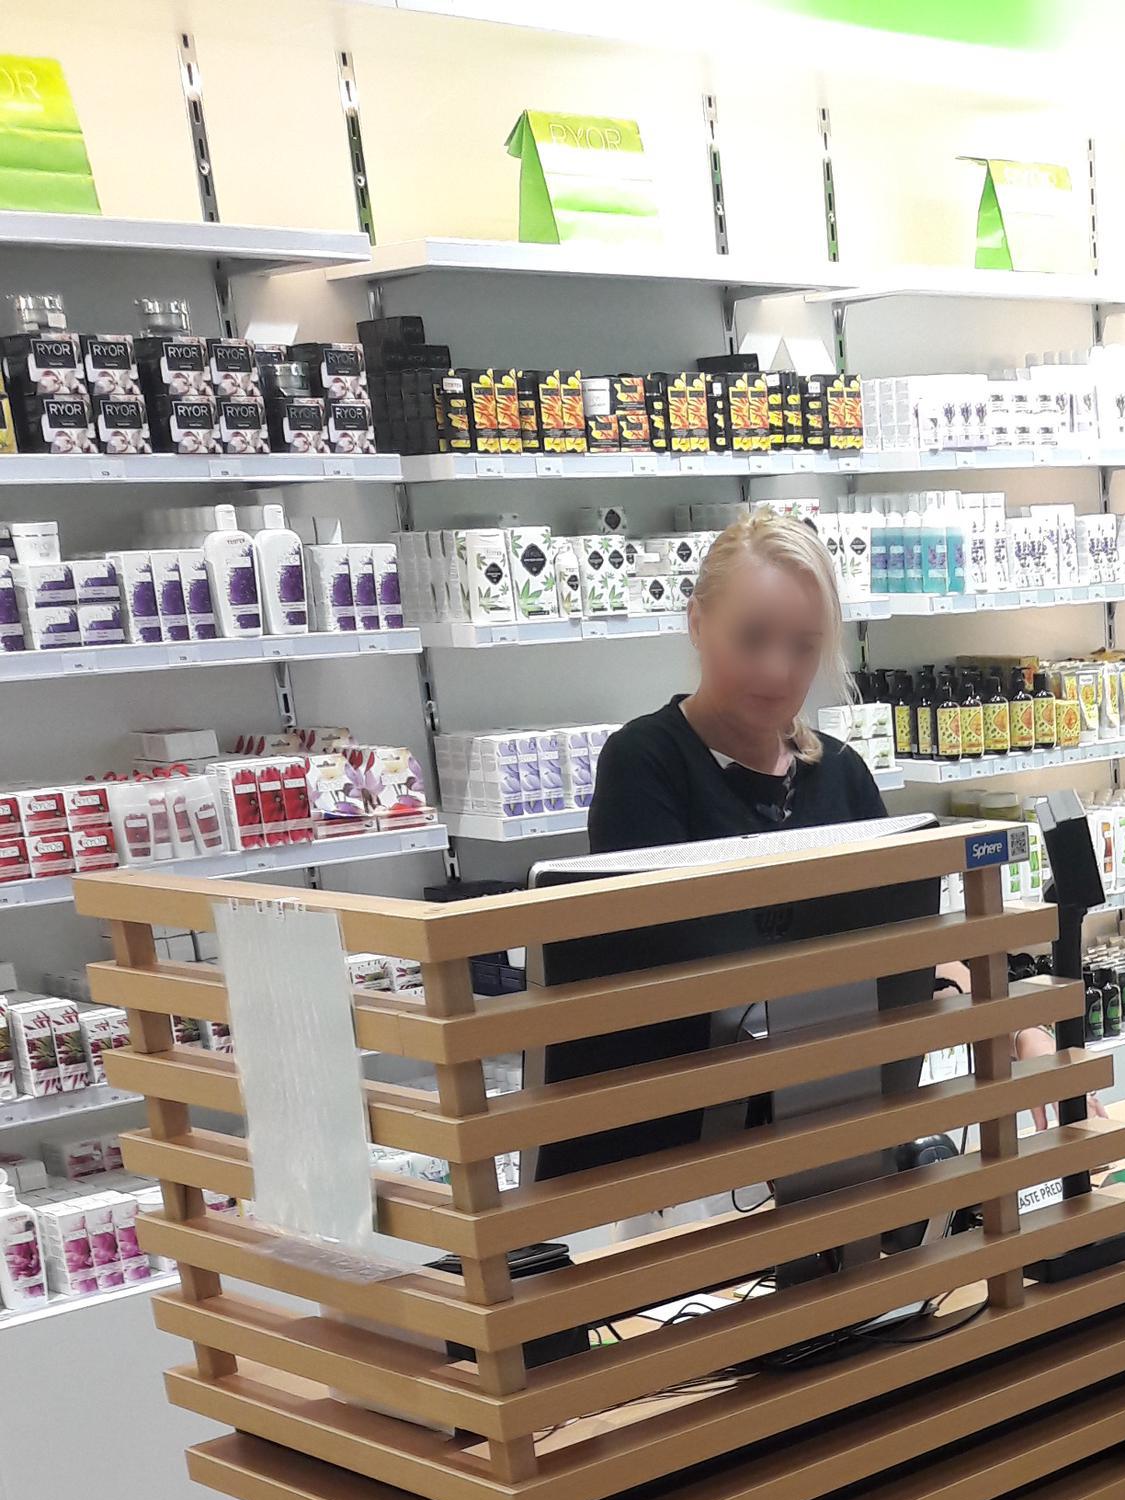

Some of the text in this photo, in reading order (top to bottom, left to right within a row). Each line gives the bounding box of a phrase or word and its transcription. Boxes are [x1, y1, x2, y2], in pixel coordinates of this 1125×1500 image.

[550, 122, 621, 150] RYOR
[36, 343, 71, 356] RYOR
[93, 343, 126, 357] RYOR
[168, 346, 199, 358] RYOR
[217, 347, 247, 360] RYOR
[327, 352, 356, 363] RYOR
[50, 403, 82, 416] RYOR
[106, 403, 137, 416] RYOR
[177, 405, 208, 417] RYOR
[226, 406, 256, 418] RYOR
[290, 407, 319, 419] RYOR
[335, 408, 364, 419] RYOR
[972, 842, 1003, 859] Sphere
[1019, 1182, 1062, 1209] ASTE PŘED
